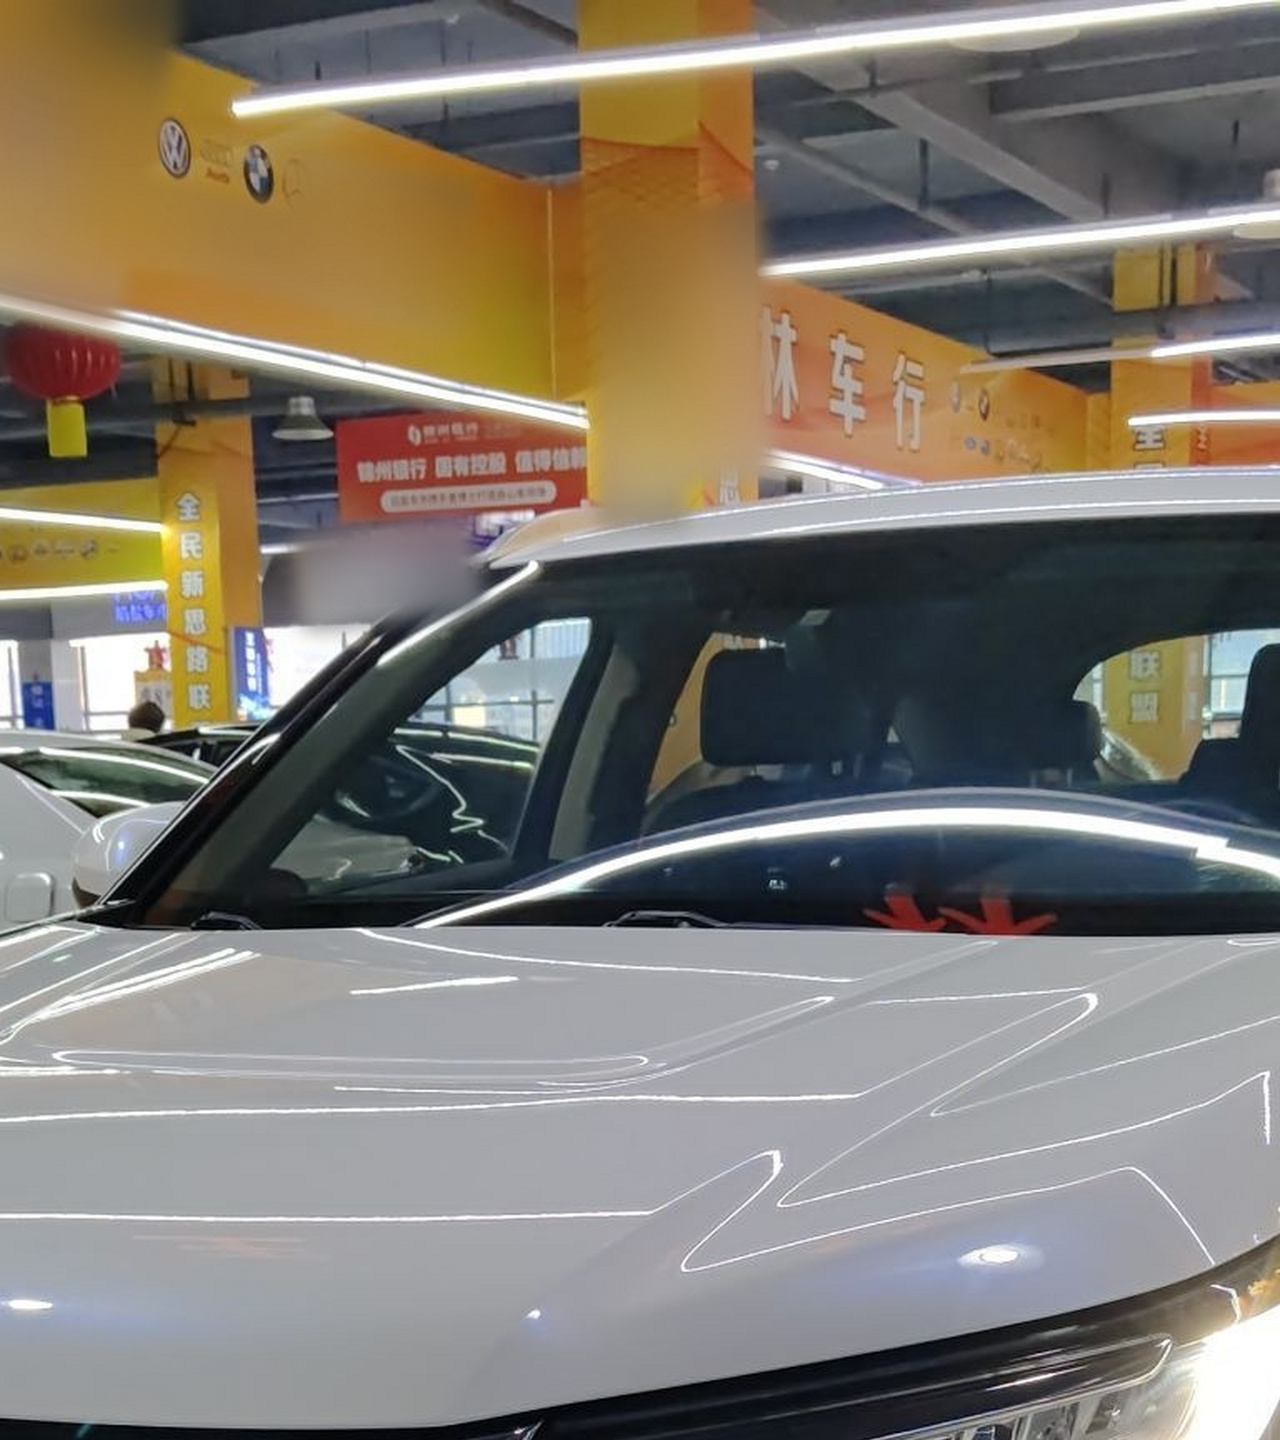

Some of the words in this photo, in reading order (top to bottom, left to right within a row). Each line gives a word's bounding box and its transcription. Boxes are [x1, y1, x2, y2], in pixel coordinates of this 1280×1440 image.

[760, 304, 926, 452] 林车行
[176, 491, 212, 725] 全民新思路联
